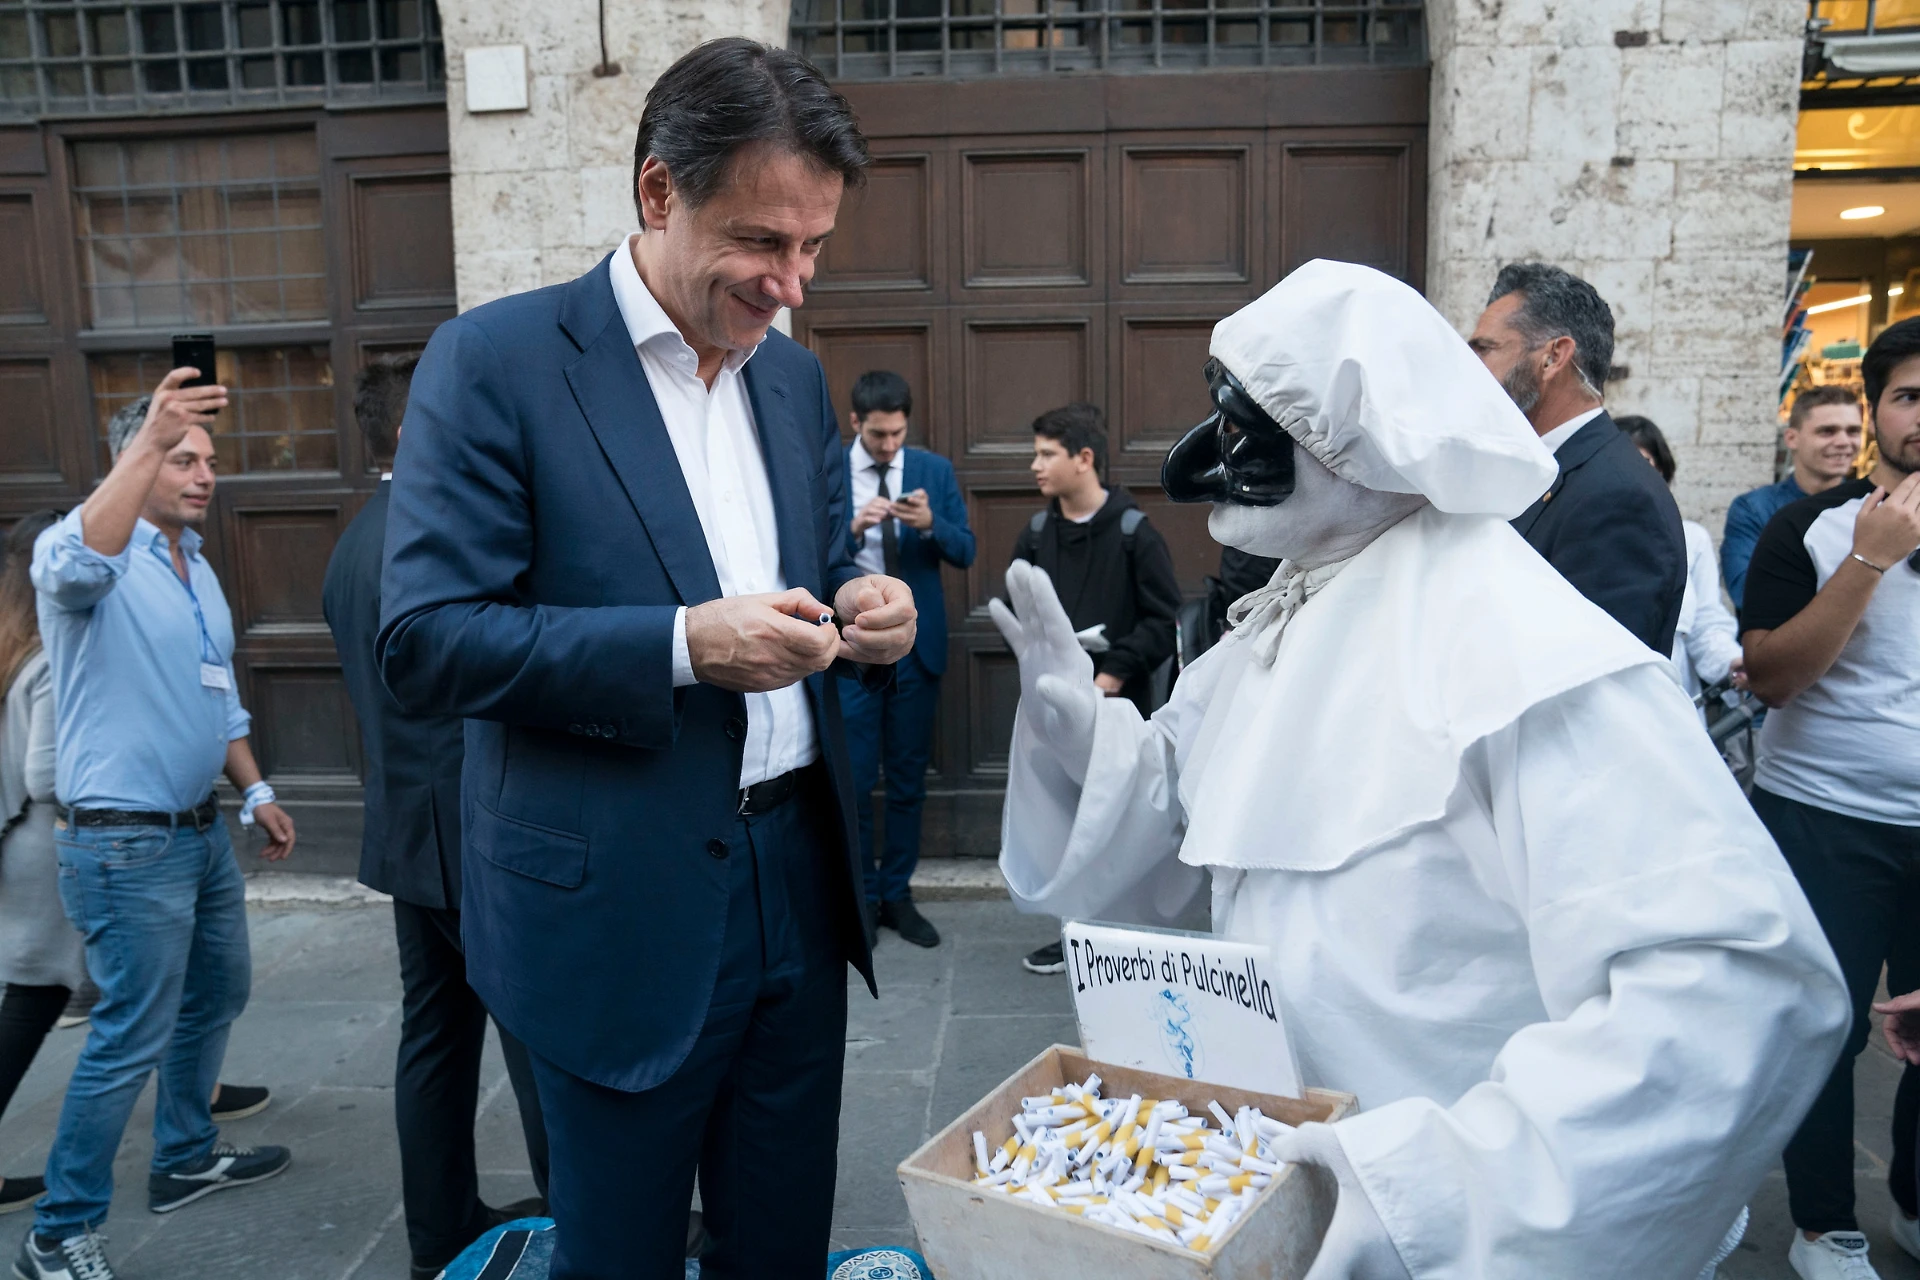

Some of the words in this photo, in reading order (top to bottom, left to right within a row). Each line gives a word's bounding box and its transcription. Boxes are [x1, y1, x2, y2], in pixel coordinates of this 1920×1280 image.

[1071, 938, 1085, 992] I
[1085, 938, 1156, 988] Proverbi
[1161, 950, 1178, 984] di
[1182, 952, 1277, 1023] Pulcinella
